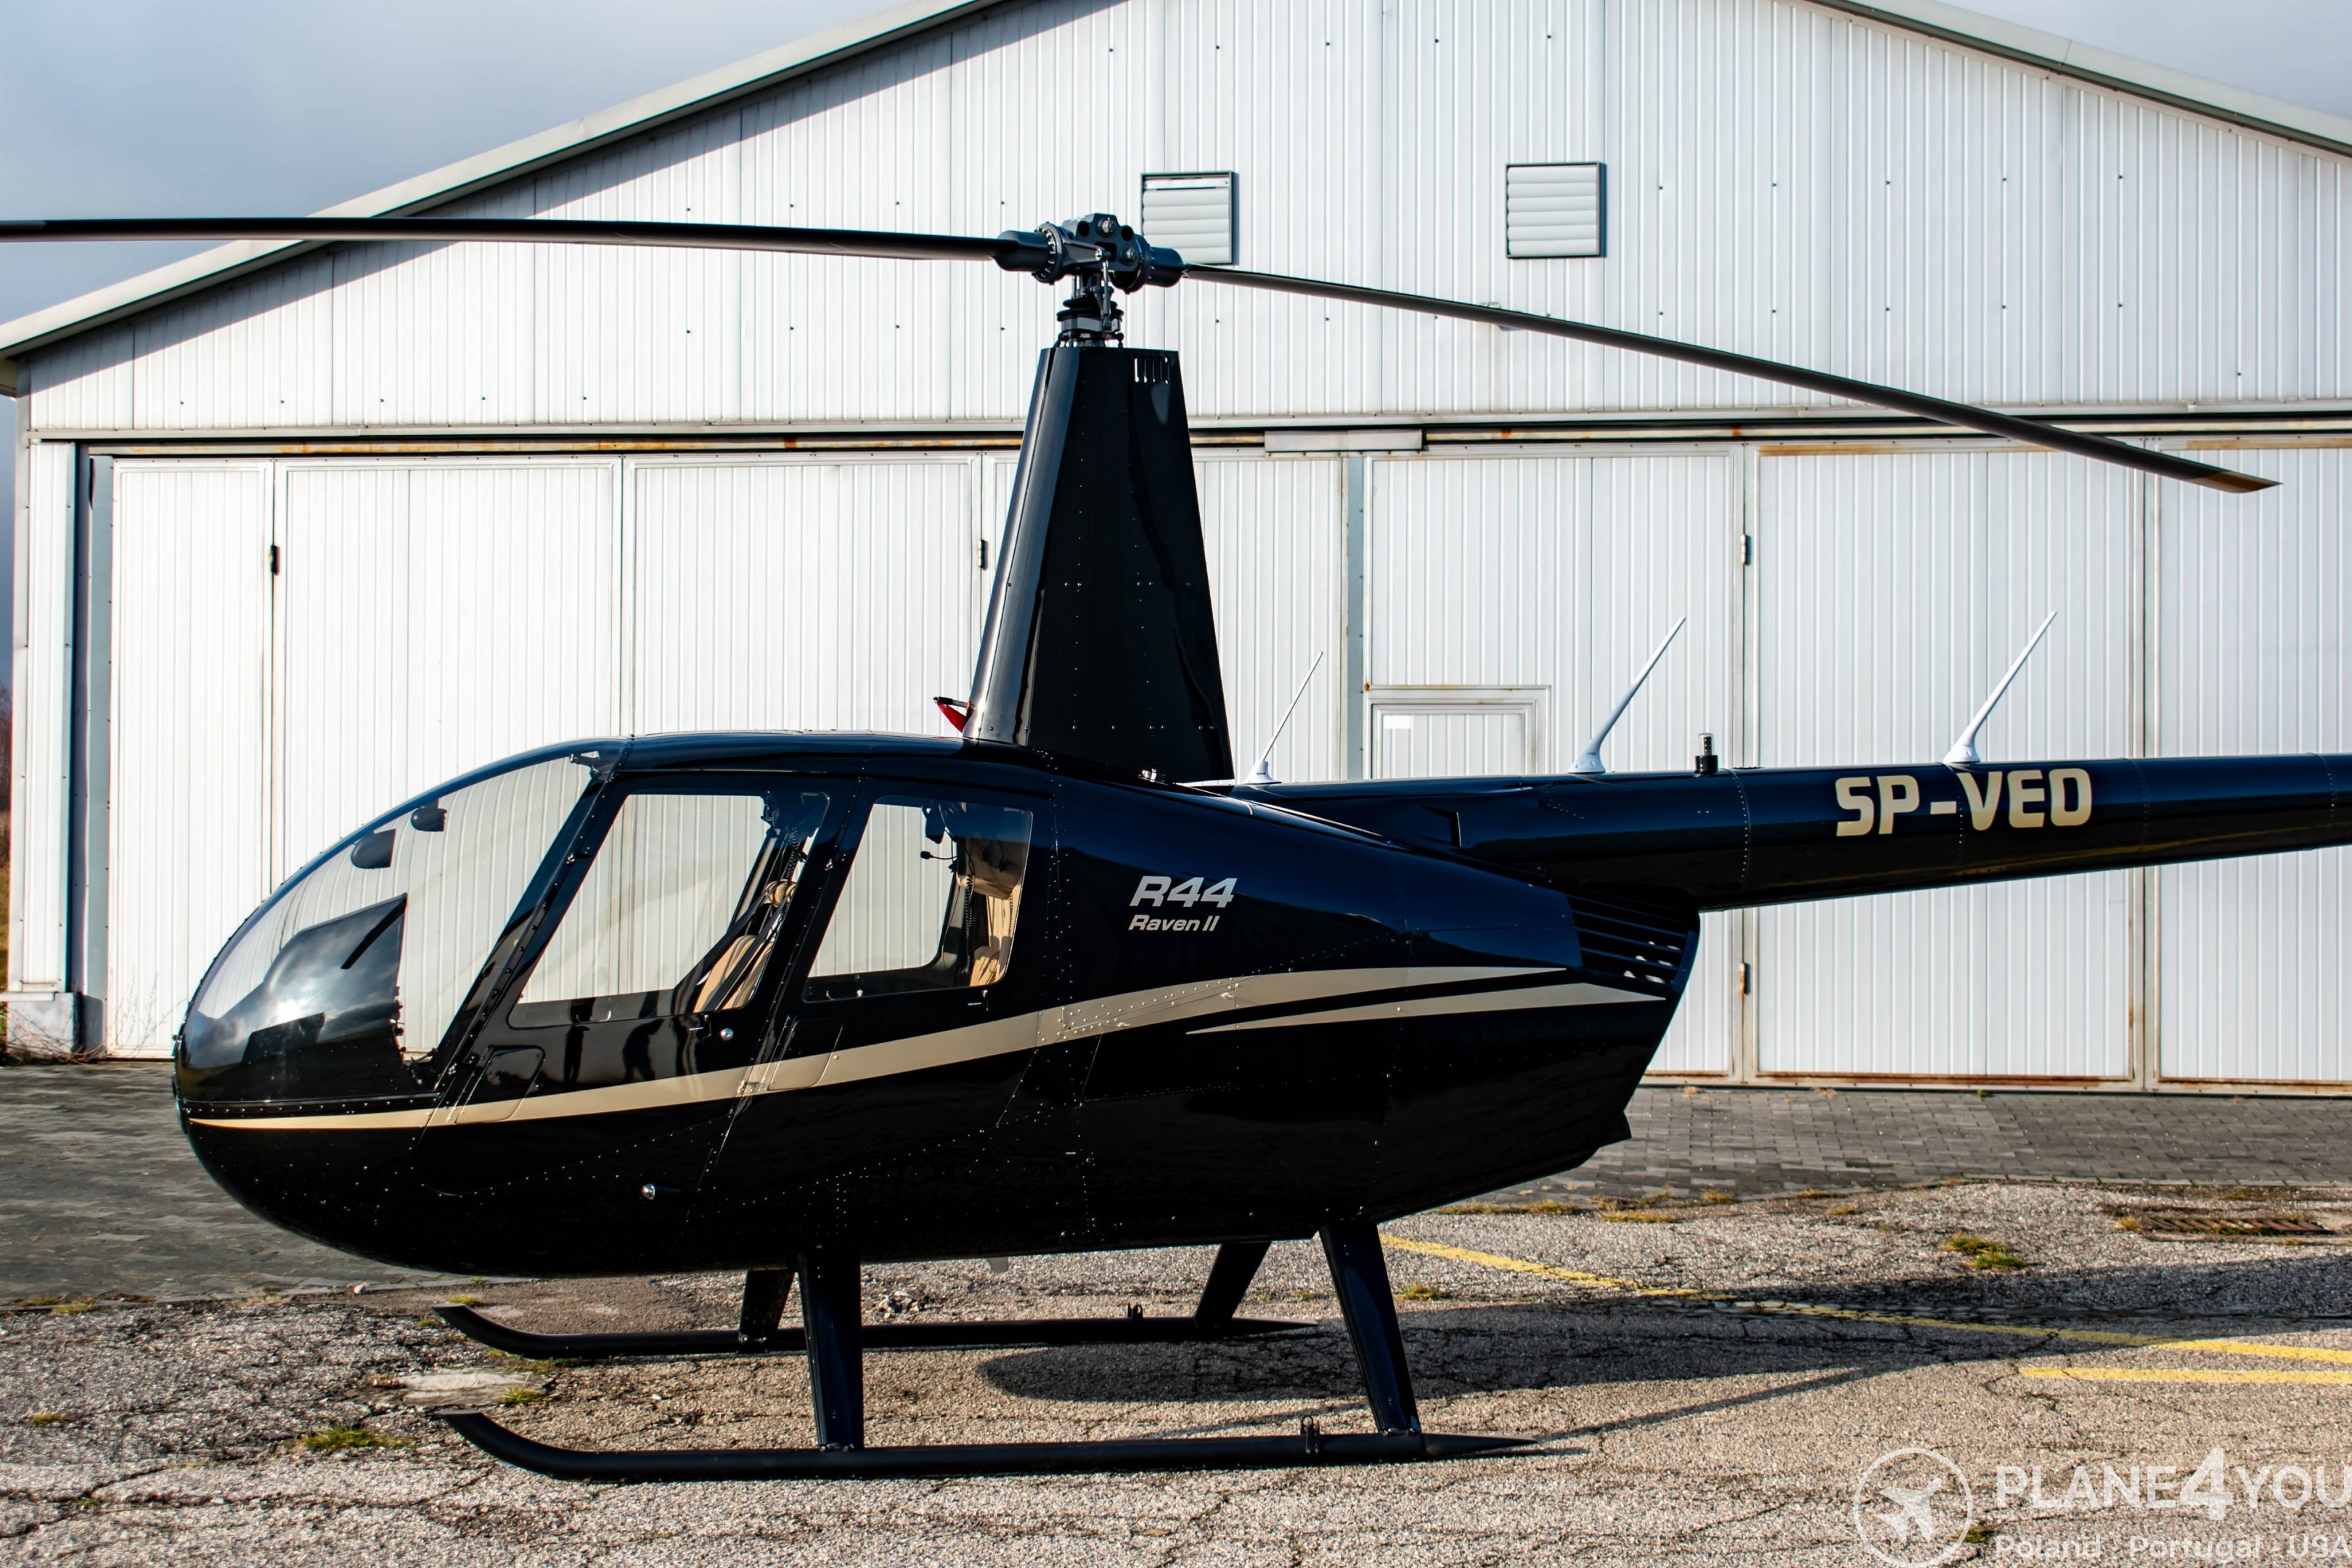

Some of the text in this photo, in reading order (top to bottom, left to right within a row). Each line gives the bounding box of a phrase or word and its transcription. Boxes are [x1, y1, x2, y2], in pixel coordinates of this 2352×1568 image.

[1130, 875, 1238, 907] R44
[1128, 915, 1220, 931] Raven II
